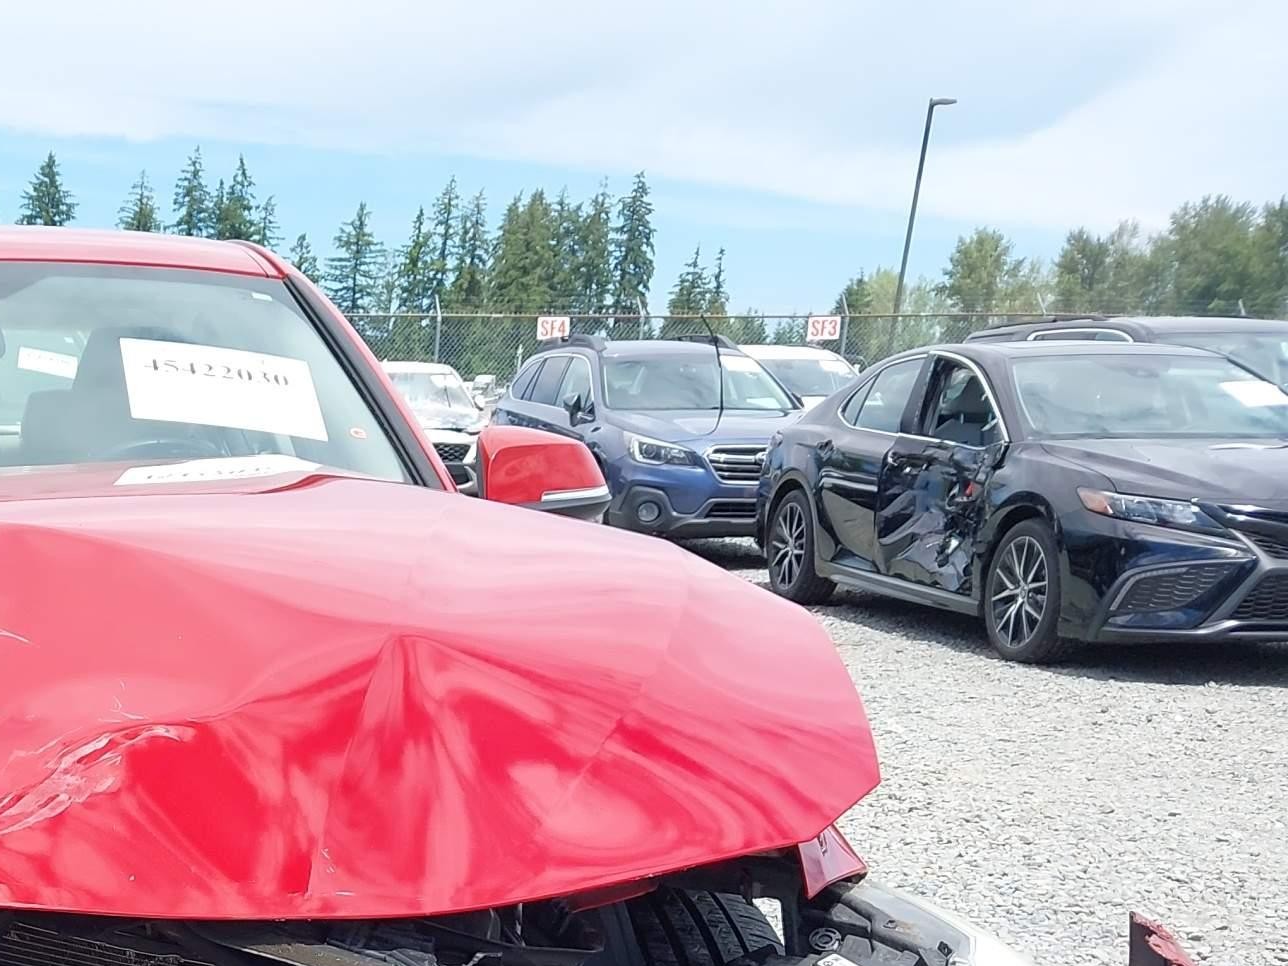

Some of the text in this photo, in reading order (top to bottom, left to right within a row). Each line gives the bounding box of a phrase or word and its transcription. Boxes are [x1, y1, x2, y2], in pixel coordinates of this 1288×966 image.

[541, 319, 566, 337] SF4
[811, 319, 838, 337] SF3
[143, 357, 290, 387] 45422030
